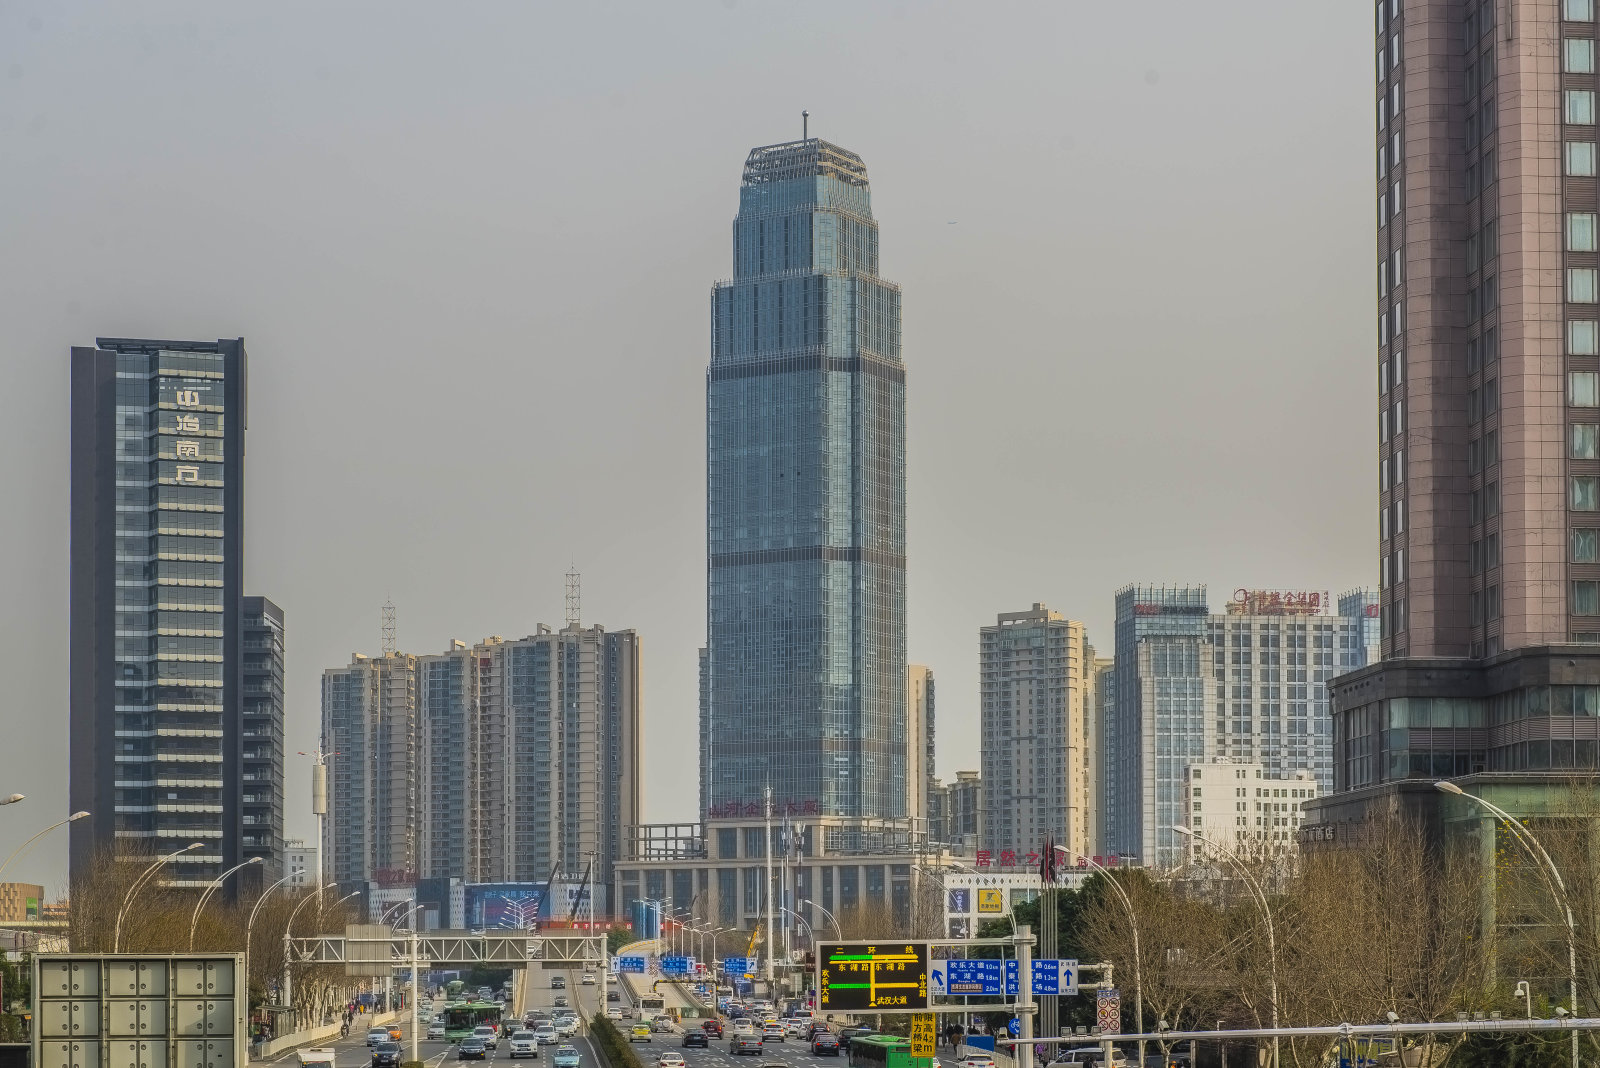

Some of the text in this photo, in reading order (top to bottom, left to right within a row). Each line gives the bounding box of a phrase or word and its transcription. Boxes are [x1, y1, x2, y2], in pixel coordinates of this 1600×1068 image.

[176, 390, 200, 482] 中冶南方
[835, 945, 914, 955] 二环线
[838, 963, 906, 972] 东湖路 东湖路
[950, 961, 985, 969] 欢乐大道
[950, 972, 985, 980] 东湖路
[821, 968, 830, 1004] 欢乐大道
[919, 972, 927, 998] 中北路
[876, 995, 908, 1005] 武汉大道
